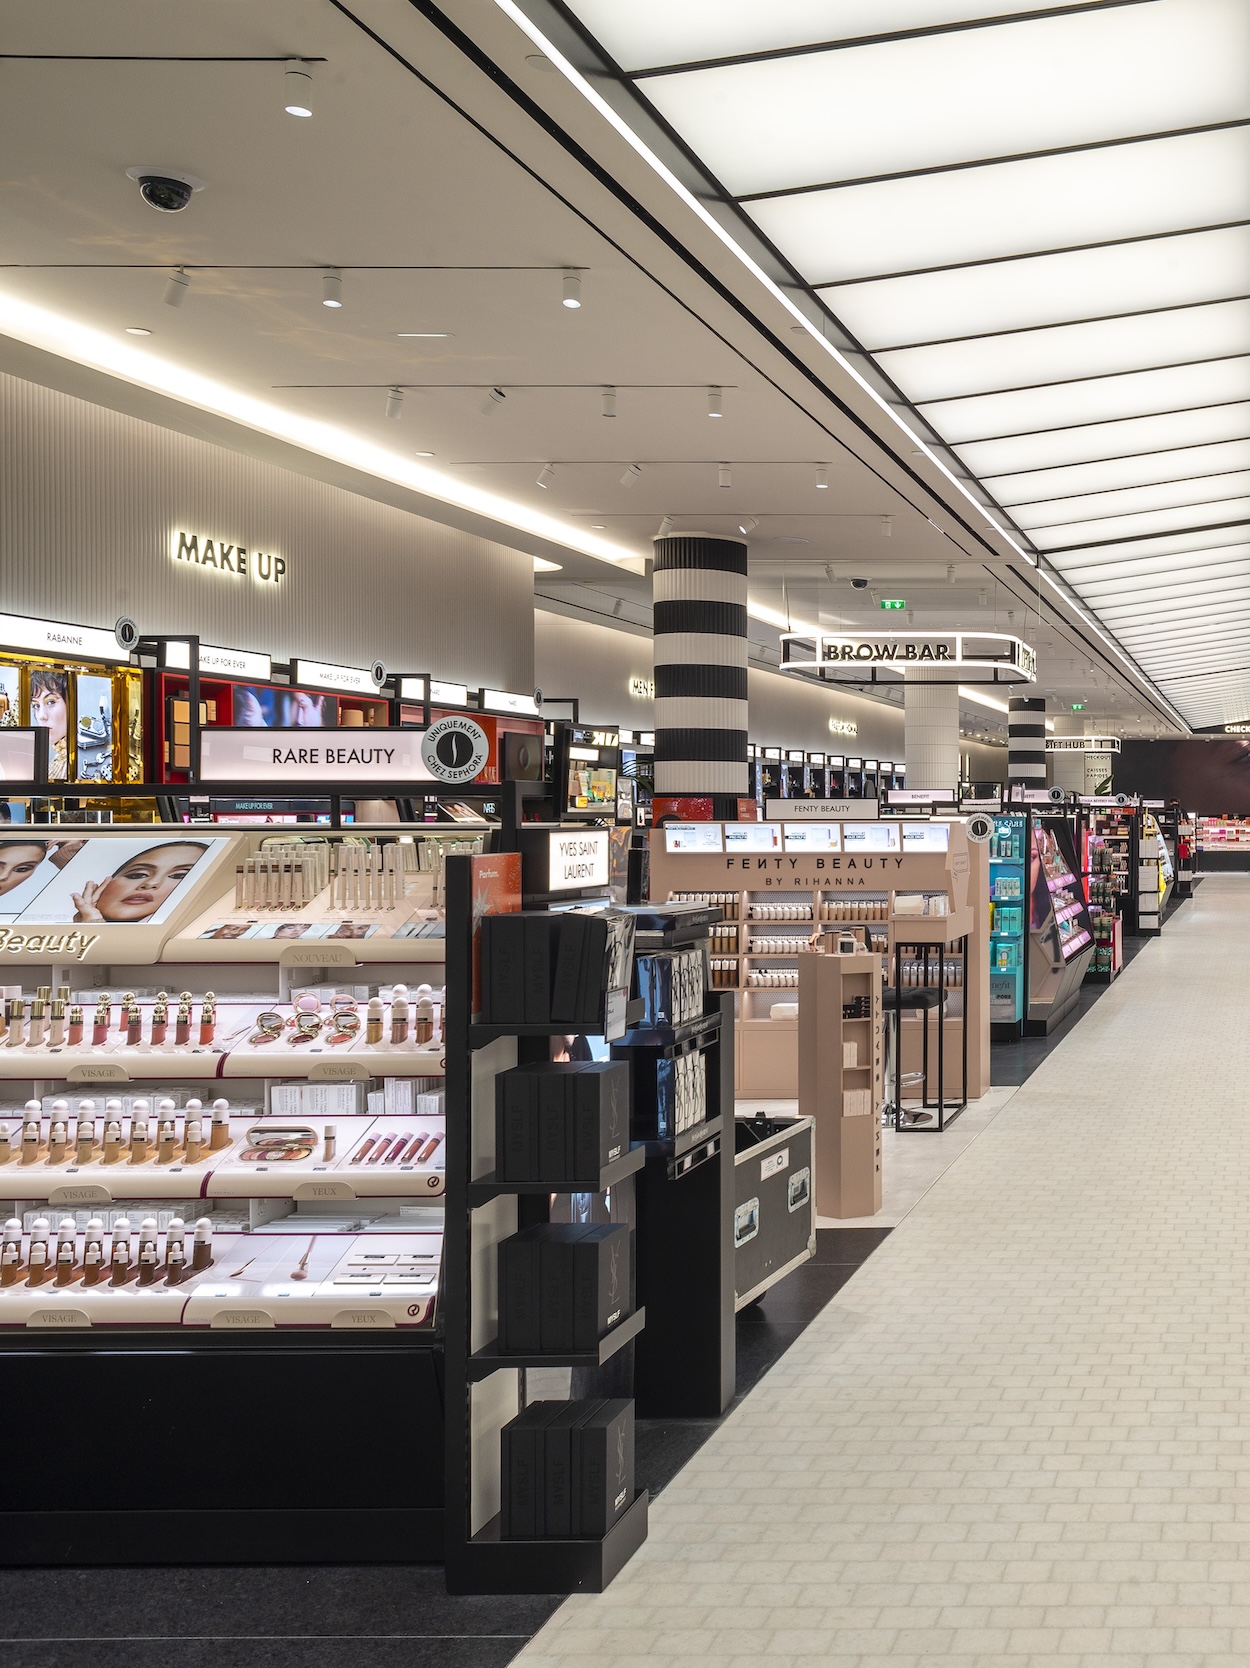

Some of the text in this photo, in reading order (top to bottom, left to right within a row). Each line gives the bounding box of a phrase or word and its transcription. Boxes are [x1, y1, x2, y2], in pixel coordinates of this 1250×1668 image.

[177, 531, 286, 583] MAKE UP
[47, 632, 83, 646] RABANNE
[828, 644, 950, 661] BROW BAR
[199, 655, 247, 669] AKE UP FOR EVER
[427, 720, 482, 743] UNIQUEMENT
[1065, 741, 1085, 749] HUB
[272, 748, 396, 764] RARE BEAUTY
[427, 753, 483, 779] CHEZ SEPHORA
[235, 802, 247, 810] MAKE
[794, 805, 850, 813] FENTY BEAUTY
[559, 840, 599, 857] YVES SAINT
[727, 858, 903, 869] FENTY BEAUTY
[564, 863, 594, 880] LAURENT
[0, 928, 100, 962] Beauty
[293, 954, 342, 963] NOUVEAU
[81, 1069, 116, 1078] VISAGE
[322, 1067, 357, 1076] VISAGE
[62, 1190, 98, 1199] VISAGE
[312, 1187, 337, 1196] YEUX
[41, 1313, 78, 1324] VISAGE
[226, 1315, 260, 1324] VISAGE
[351, 1315, 376, 1324] YEUX
